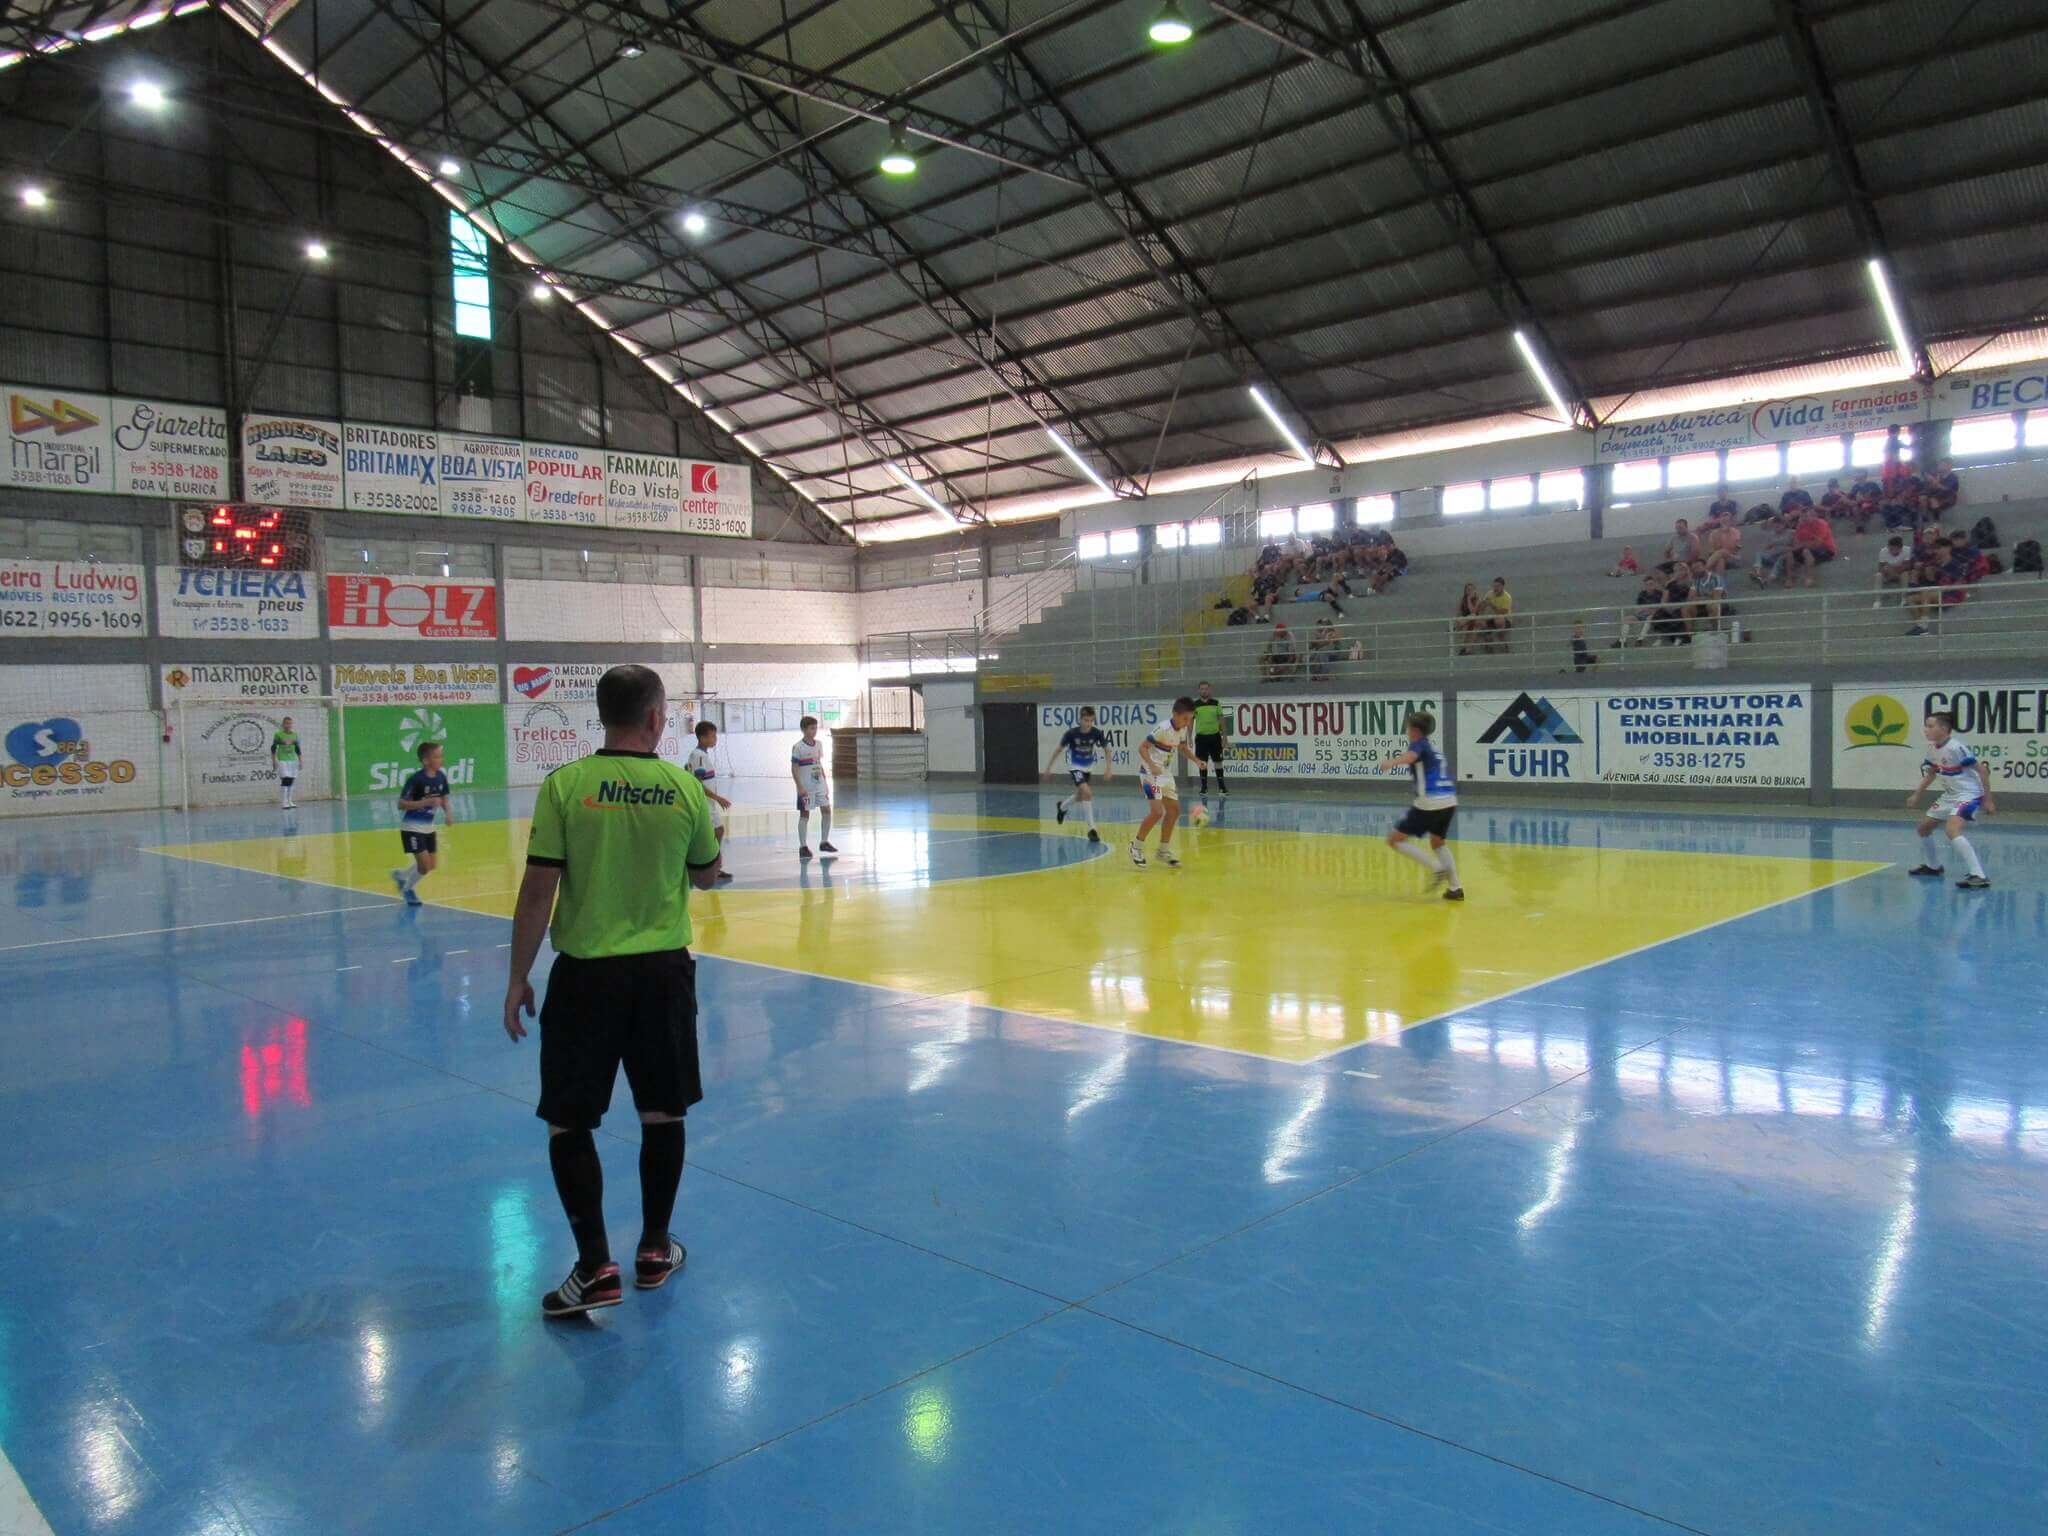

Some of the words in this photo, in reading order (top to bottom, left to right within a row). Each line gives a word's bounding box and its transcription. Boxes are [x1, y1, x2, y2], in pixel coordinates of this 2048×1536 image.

[1971, 375, 2048, 410] BEC
[1769, 404, 1825, 429] Vida
[115, 404, 227, 451] Giaretta
[246, 421, 340, 456] NOROESTE
[346, 427, 436, 450] BRITADORES
[150, 441, 227, 457] SUPERMERCADO
[256, 443, 328, 468] LAJES
[529, 447, 579, 461] MERCADO
[149, 462, 219, 480] 3538-1288
[347, 448, 436, 486] BRITAMAX
[441, 455, 477, 477] BOA
[482, 457, 524, 480] VISTA
[528, 460, 604, 481] POPULAR
[131, 479, 155, 490] BOA
[609, 478, 636, 497] Boa
[643, 481, 680, 501] Vista
[452, 491, 517, 506] 3538-1260
[54, 560, 138, 601] Ludwig
[175, 568, 307, 599] TCHEKA
[258, 599, 305, 615] pneus
[343, 584, 486, 627] HOLZ
[210, 617, 289, 632] 3538-1633
[335, 664, 407, 690] Móveis
[413, 664, 448, 685] Boa
[451, 664, 497, 685] Vista
[562, 665, 603, 677] MERCADO
[555, 679, 567, 689] DA
[1607, 693, 1804, 710] CONSTRUTORA
[1619, 712, 1784, 728] ENGENHARIA
[512, 726, 577, 742] Treliças
[1314, 737, 1332, 748] Seu
[1337, 737, 1368, 748] Sonho
[1374, 737, 1393, 748] Por
[1222, 747, 1297, 761] CONSTRUIR
[1315, 749, 1333, 761] 55
[1340, 749, 1379, 761] 3538
[1488, 748, 1571, 778] FÜHR
[1653, 752, 1746, 769] 3538-1275
[0, 759, 137, 789] cesso
[1344, 762, 1369, 775] Vista
[1602, 772, 1640, 782] AVENIDA
[1734, 775, 1758, 785] VISTA
[1761, 775, 1773, 785] DO
[598, 777, 677, 805] Nitsche
